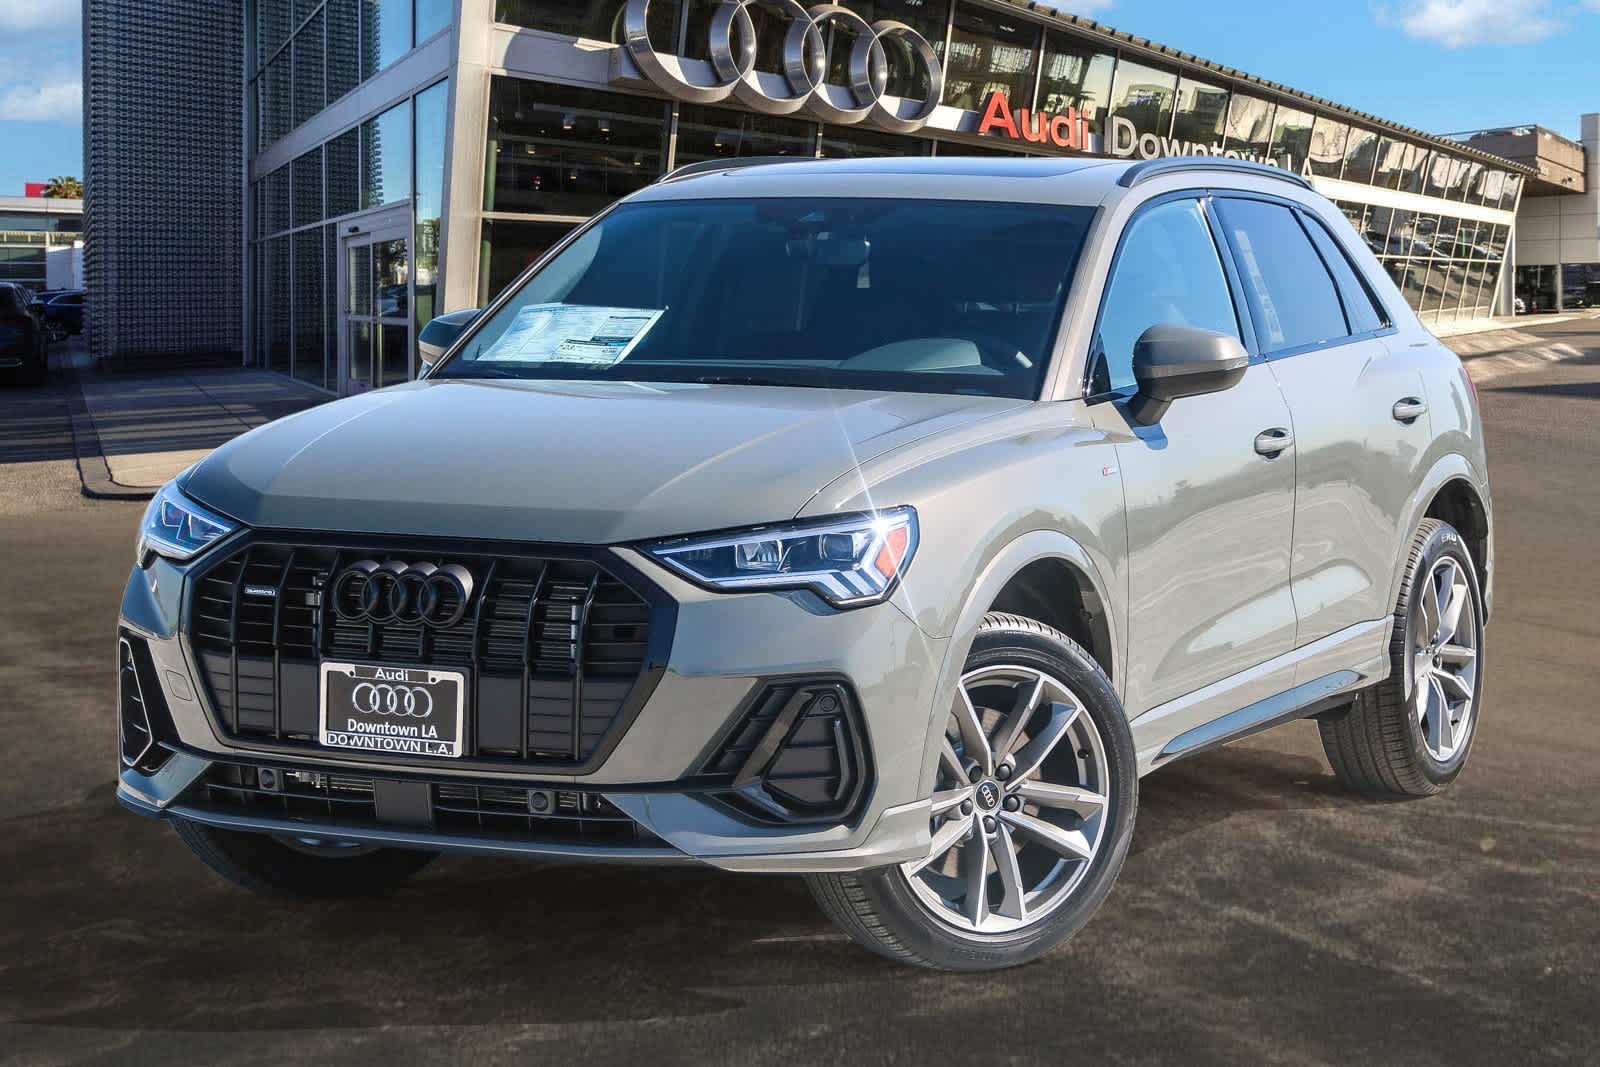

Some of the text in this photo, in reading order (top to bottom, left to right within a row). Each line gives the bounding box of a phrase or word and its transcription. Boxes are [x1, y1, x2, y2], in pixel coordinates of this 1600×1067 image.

[978, 91, 1089, 150] Audi
[375, 668, 409, 681] Audi
[347, 718, 438, 739] Downtown LA
[327, 733, 453, 755] DOWNTOWN L.A.
